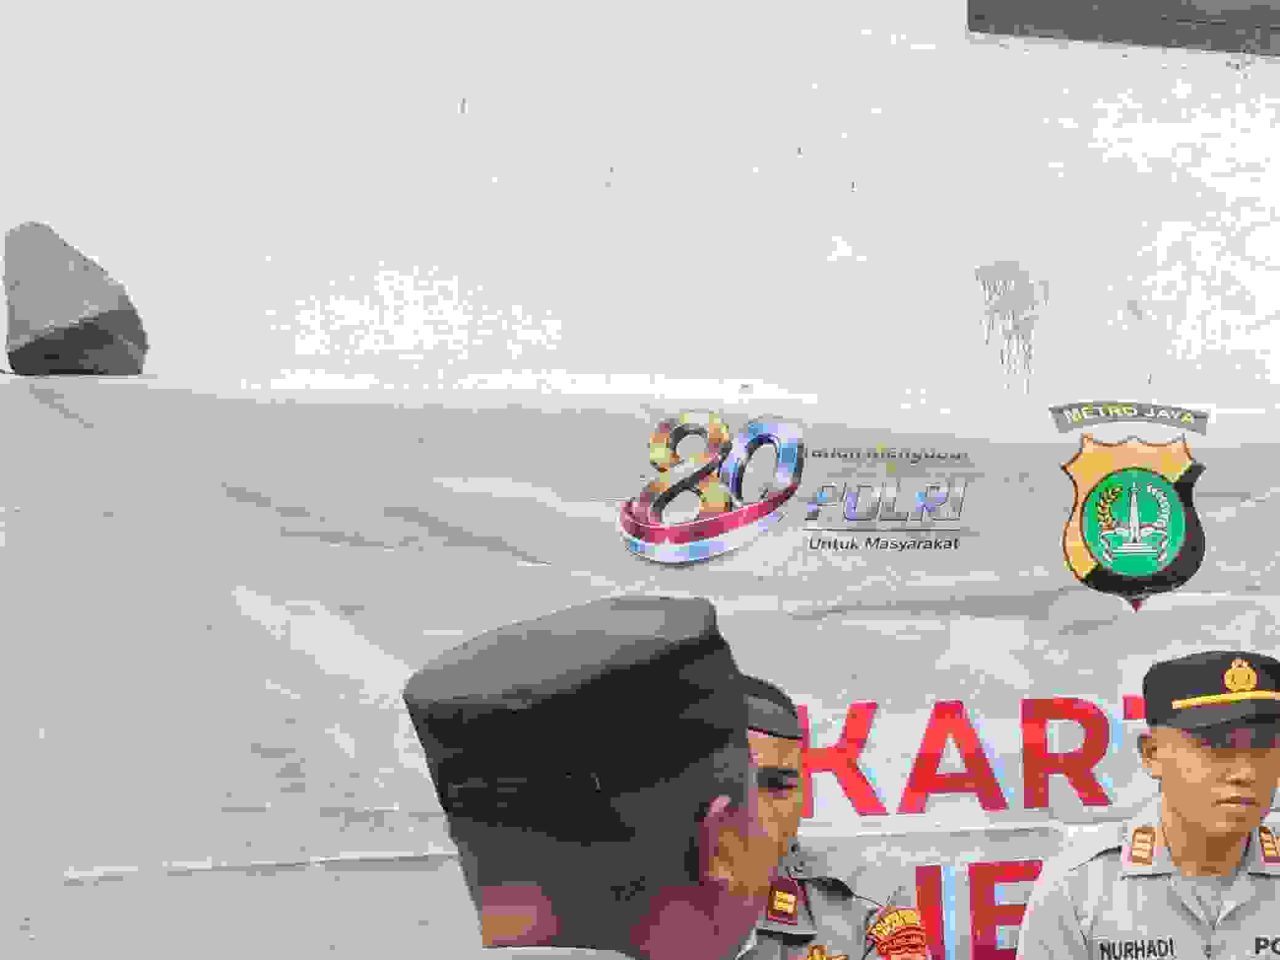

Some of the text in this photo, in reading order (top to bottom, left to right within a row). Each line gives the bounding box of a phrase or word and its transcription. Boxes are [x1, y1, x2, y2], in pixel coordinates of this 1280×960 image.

[620, 409, 806, 565] 80
[809, 535, 960, 553] Untuk Masyarakat
[1099, 936, 1176, 960] NURHADI
